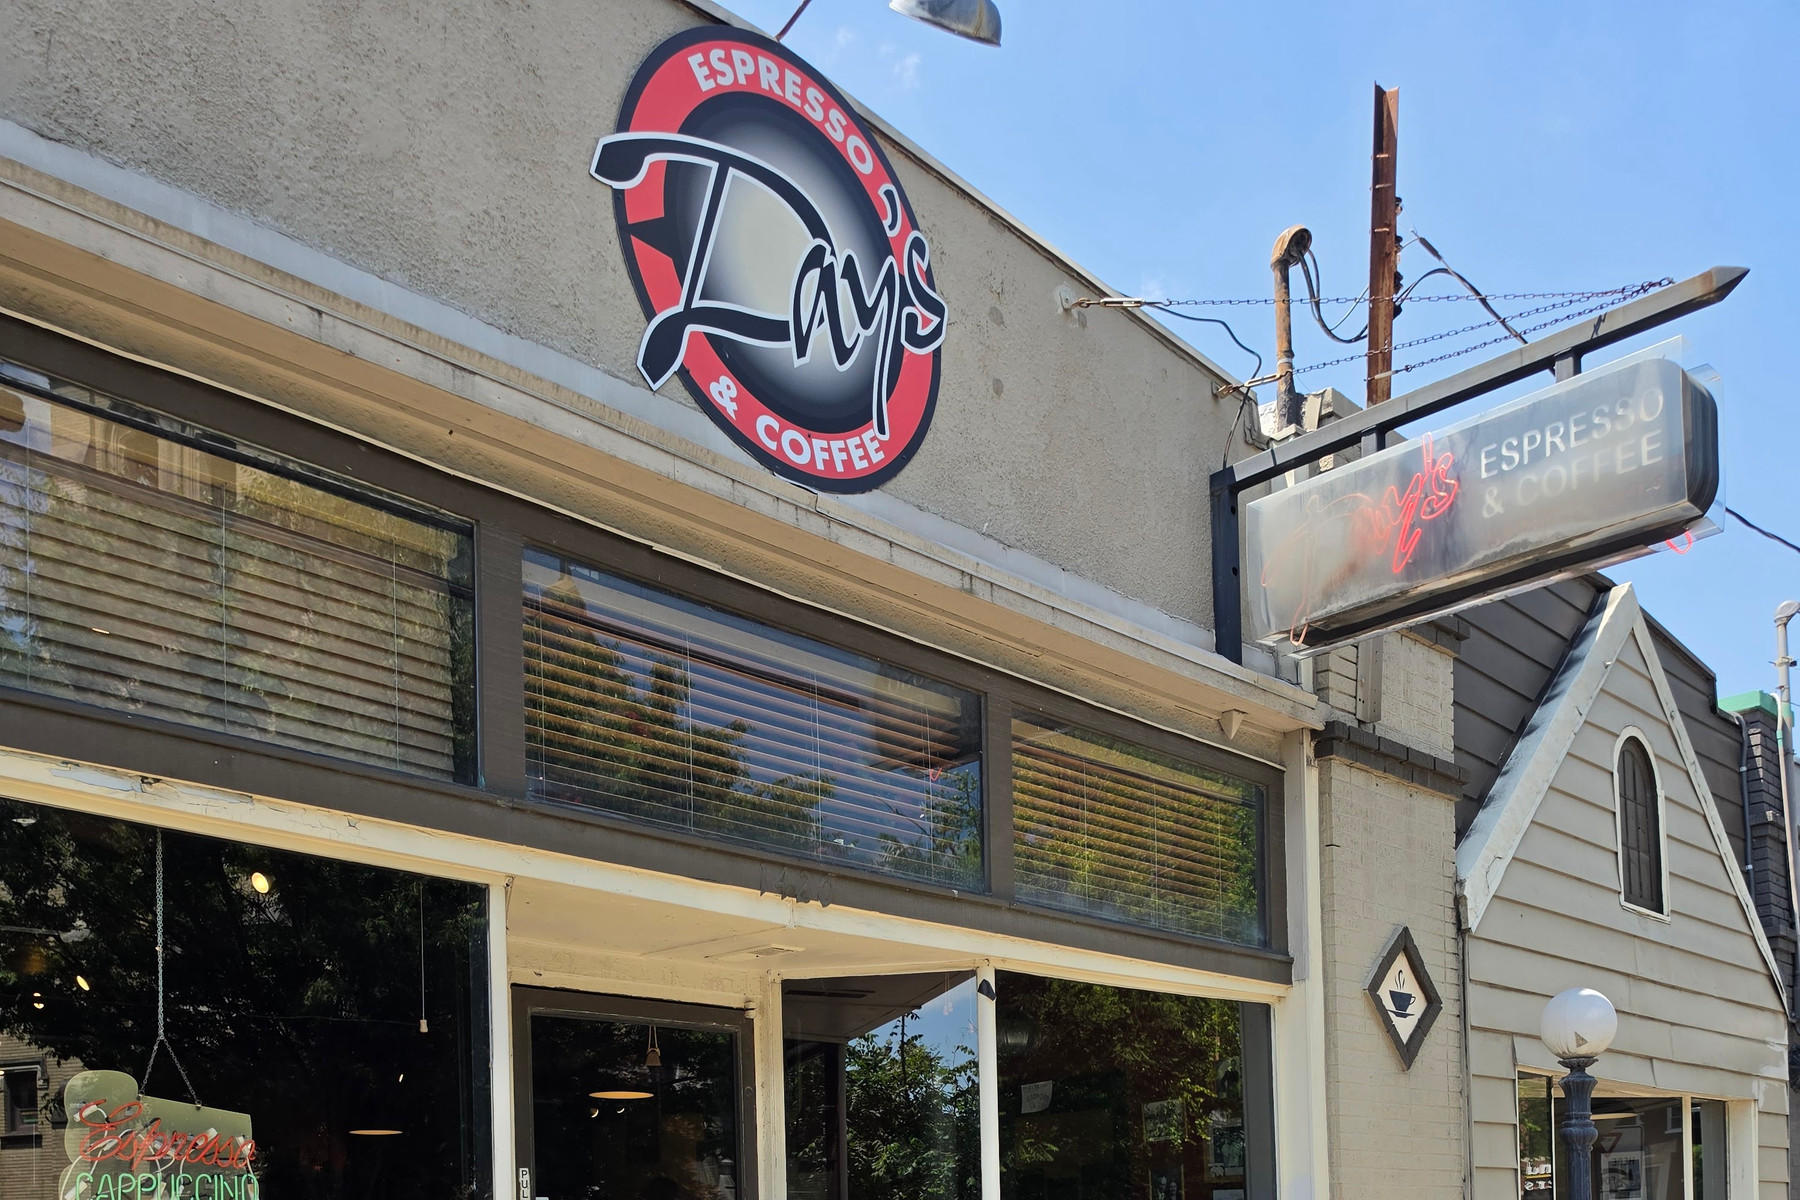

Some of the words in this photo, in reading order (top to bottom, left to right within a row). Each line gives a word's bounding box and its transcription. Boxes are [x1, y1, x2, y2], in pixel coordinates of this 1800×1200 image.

[688, 49, 874, 174] ESPRESSO
[709, 375, 738, 420] &
[756, 415, 886, 473] COFFEE
[1480, 388, 1664, 479] ESPRESSO
[1482, 486, 1504, 518] &
[1516, 429, 1663, 506] COFFEE
[79, 1099, 256, 1171] Espresso
